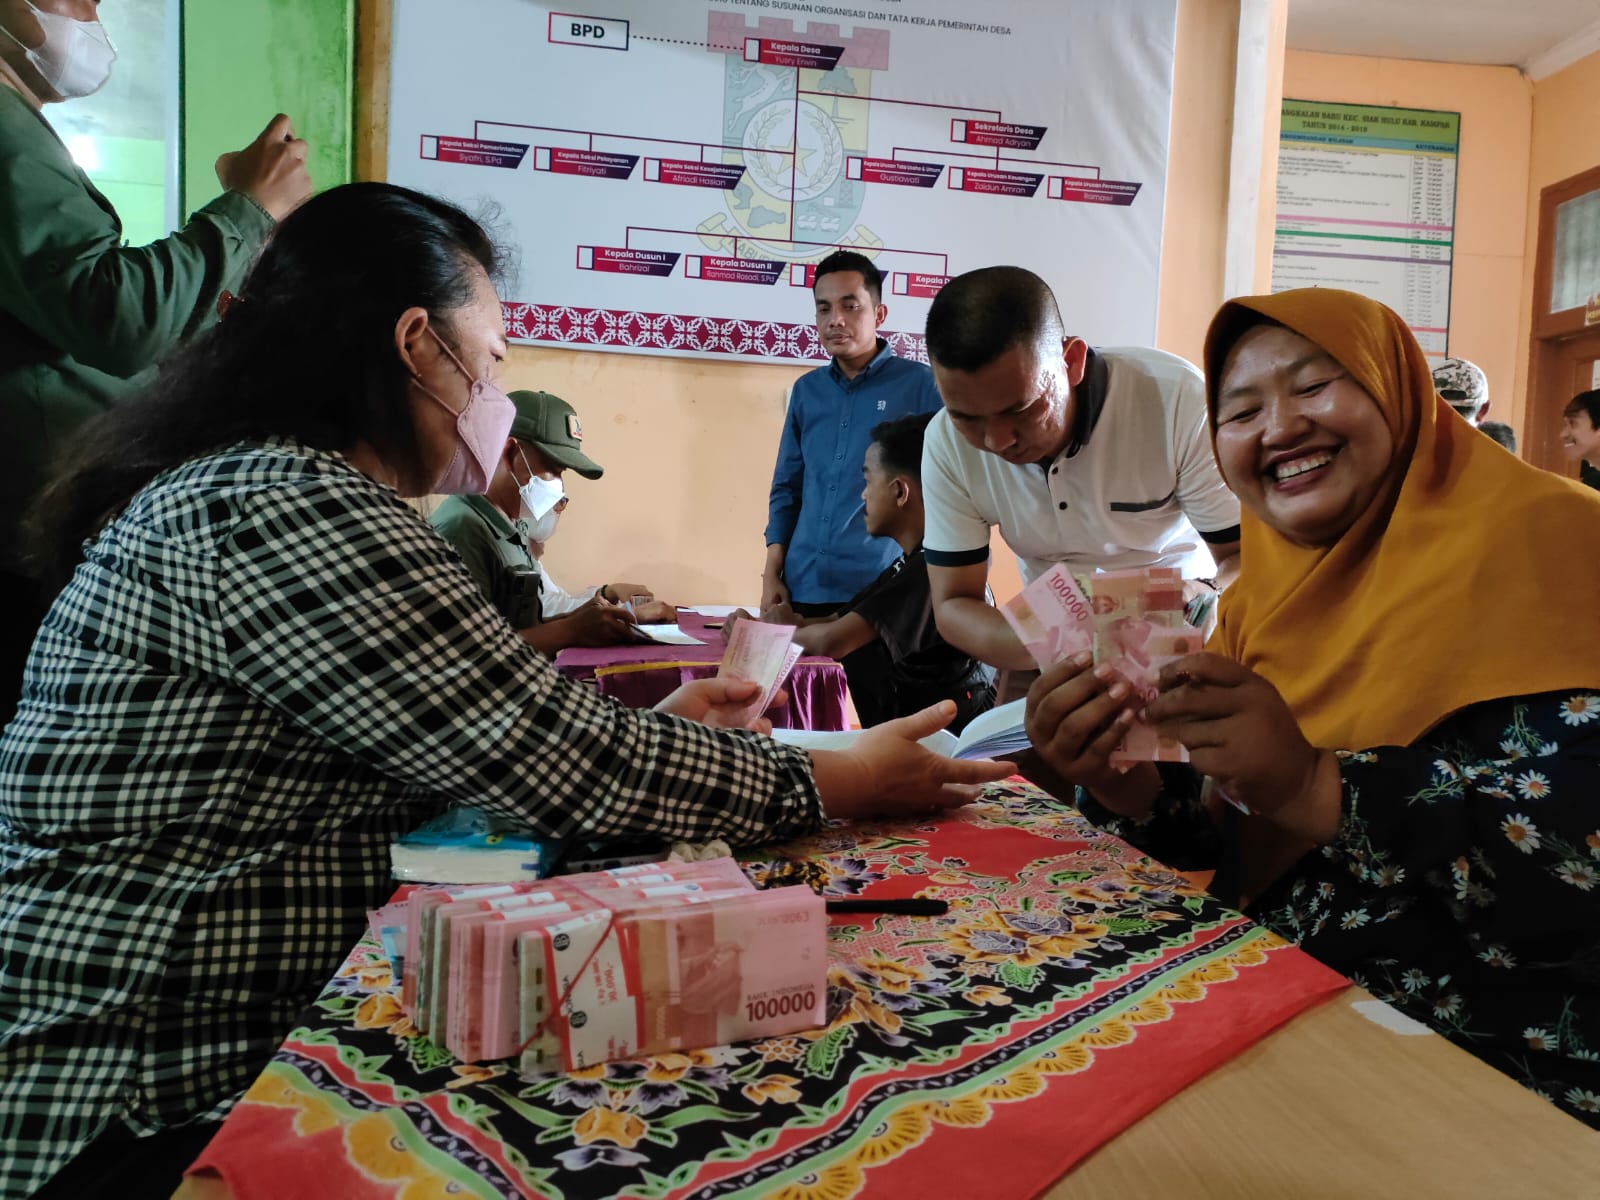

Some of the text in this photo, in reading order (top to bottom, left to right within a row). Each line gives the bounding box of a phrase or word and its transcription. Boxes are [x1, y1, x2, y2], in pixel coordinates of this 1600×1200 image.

[771, 2, 813, 13] SUSUNAN
[814, 7, 866, 18] ORGANISASI
[867, 11, 886, 21] DAN
[888, 13, 909, 24] TATA
[910, 17, 936, 27] KERJA
[938, 19, 989, 33] PEMERINTAH
[990, 26, 1012, 35] DESA
[571, 23, 605, 39] BPD
[770, 42, 821, 54] Kepala Desa
[974, 122, 1034, 135] Sekretaris Desa
[439, 140, 462, 148] Kepala
[975, 135, 1004, 144] Ahmad
[557, 152, 580, 160] Kepala
[597, 155, 629, 164] Pelayanan
[661, 162, 683, 170] Kepala
[1001, 185, 1026, 194] Amran
[604, 249, 634, 260] Kepala
[635, 252, 661, 261] Dusun
[619, 263, 650, 272] Bahrizal
[710, 258, 739, 268] Kepala
[740, 261, 766, 269] Dusun
[915, 275, 943, 285] Kepala
[1050, 571, 1090, 622] 100000
[745, 991, 816, 1022] 100000
